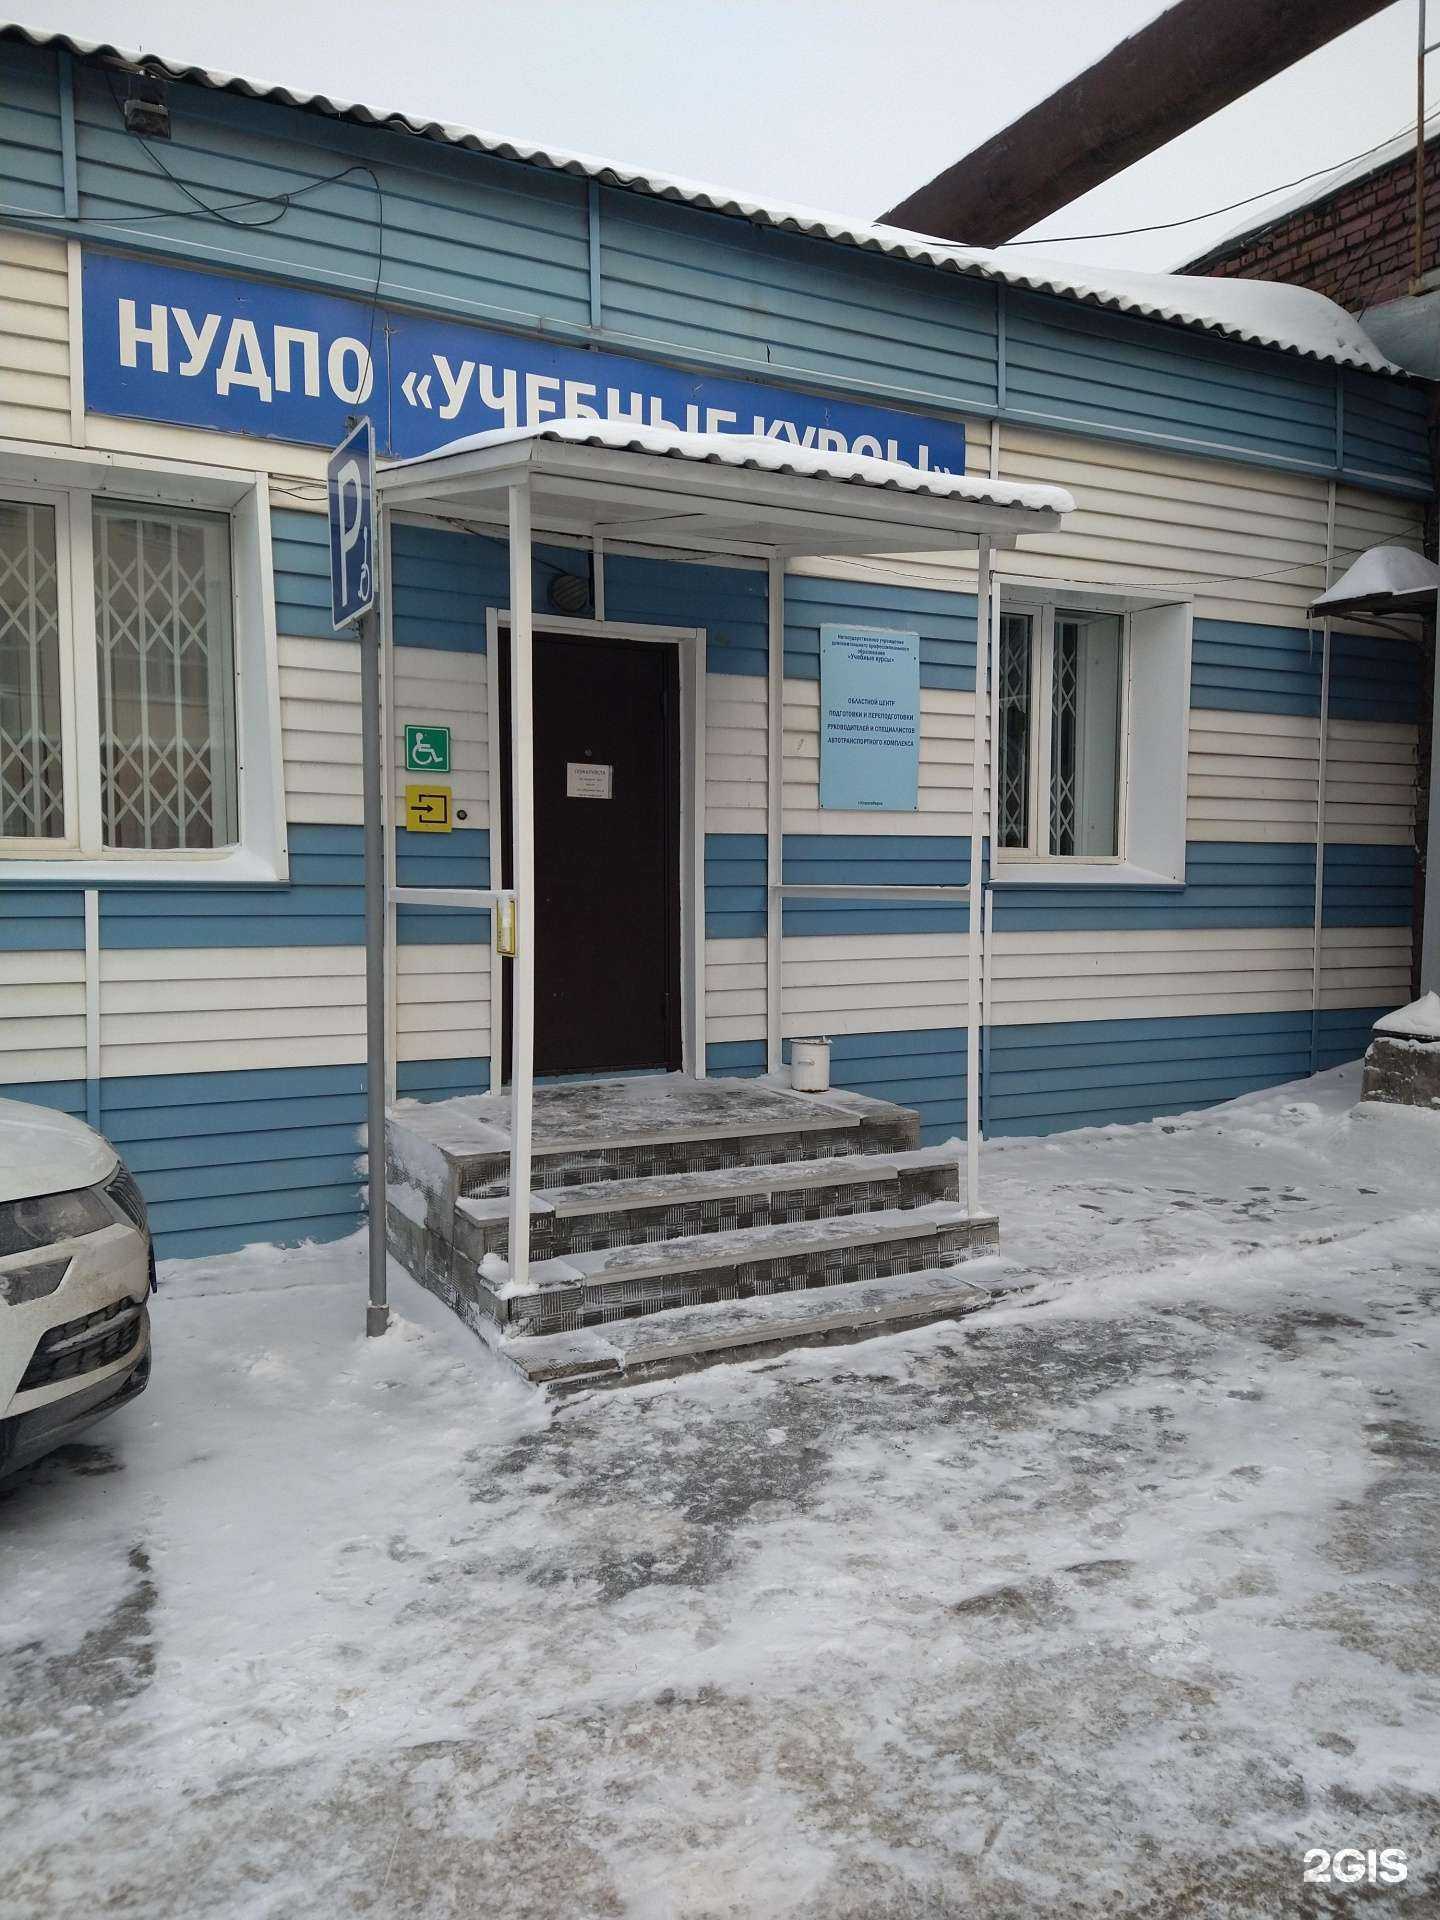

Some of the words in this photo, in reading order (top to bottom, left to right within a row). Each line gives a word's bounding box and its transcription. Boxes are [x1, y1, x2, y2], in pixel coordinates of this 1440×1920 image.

[118, 298, 374, 405] НУДПО
[847, 697, 878, 706] ОБЛАСТНОЙ
[828, 710, 863, 718] ПОДГОТОВКИ
[867, 712, 914, 721] ПЕРЕПОДГОТОВКИ
[827, 723, 870, 732] РУКОВОДИТЕЛЕЙ
[874, 725, 915, 734] СПЕЦИАЛИСТОВ
[827, 737, 883, 746] АВТОТРАНСПОРТНОГО
[883, 739, 914, 747] КОМПЛЕКСА
